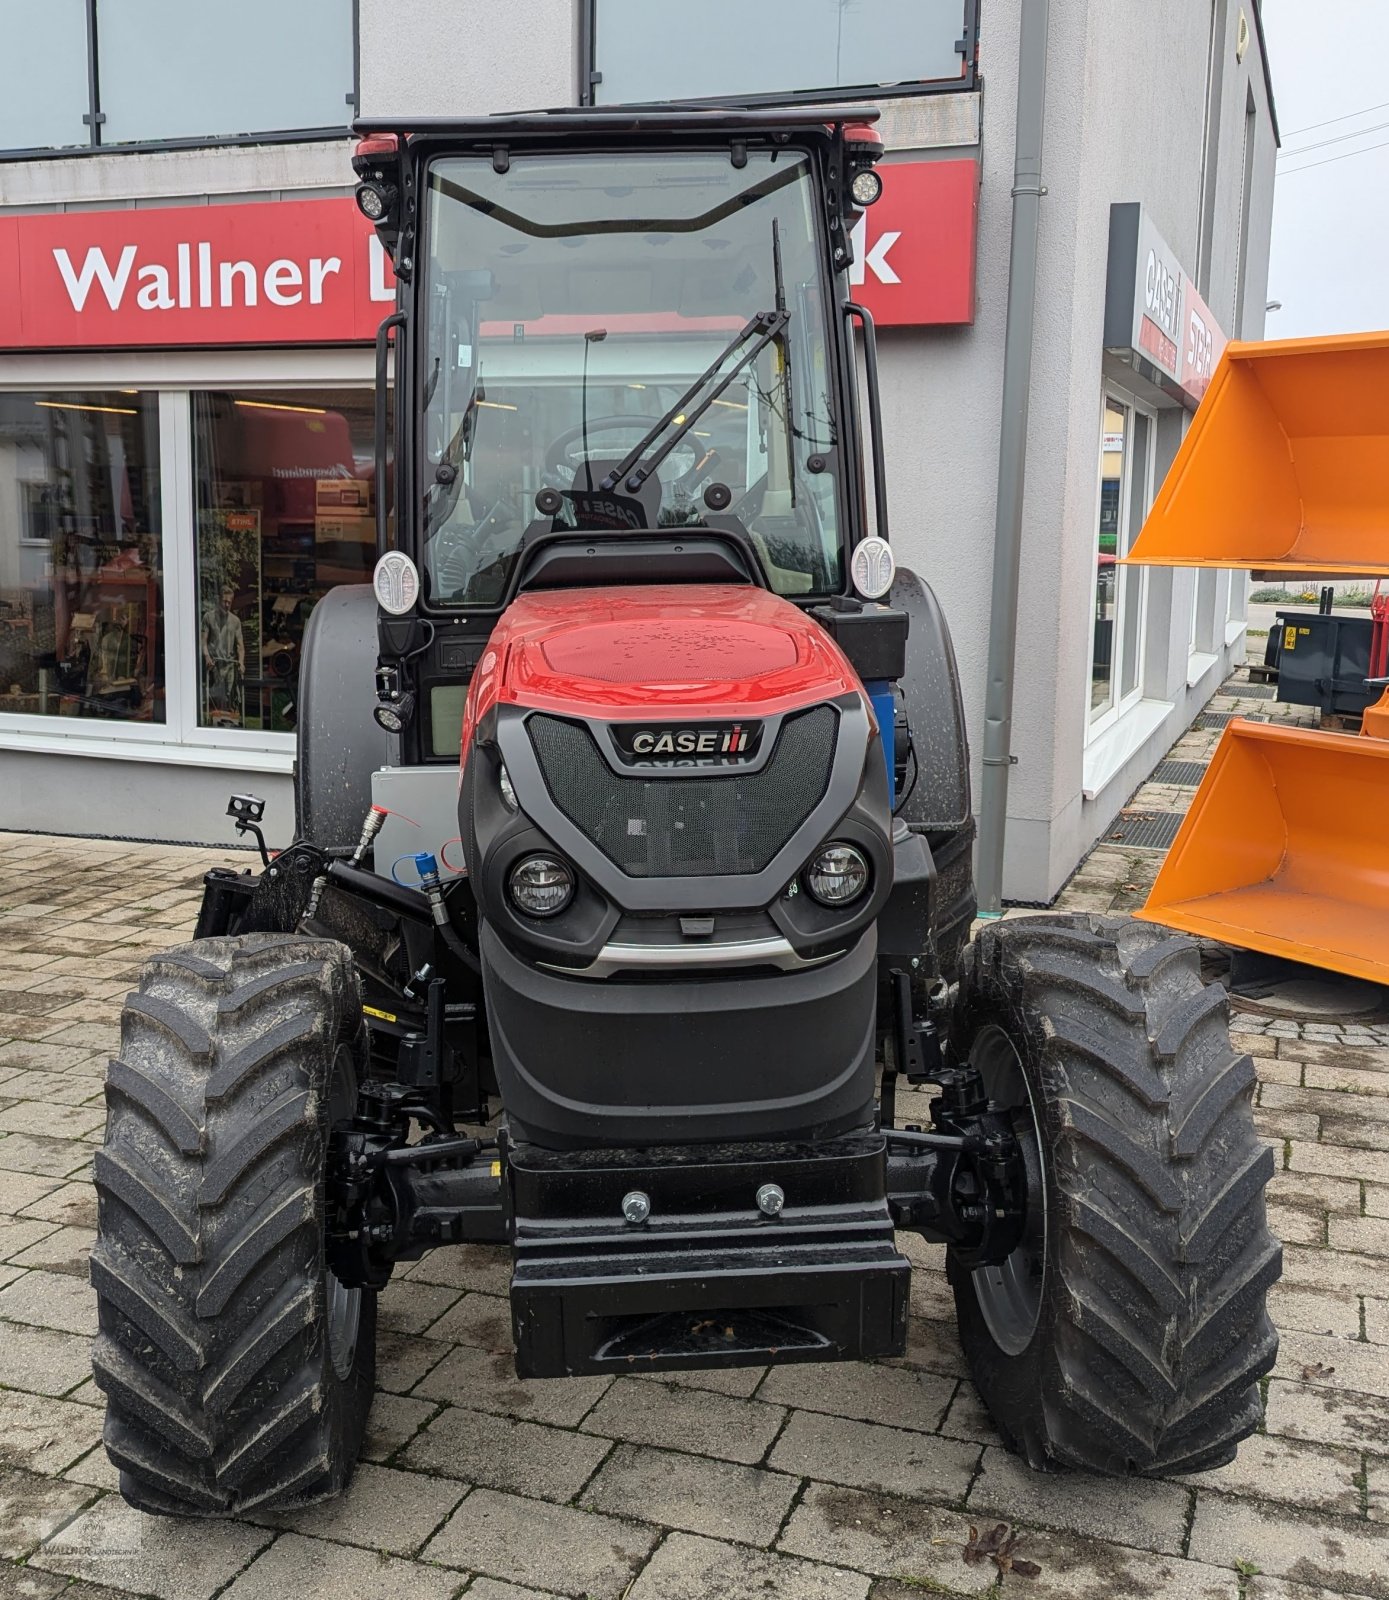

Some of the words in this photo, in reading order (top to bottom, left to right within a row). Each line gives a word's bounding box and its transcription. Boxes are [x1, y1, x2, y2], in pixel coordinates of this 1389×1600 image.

[52, 241, 342, 312] Wallner
[1145, 248, 1174, 330] CASE
[632, 732, 718, 754] CASE
